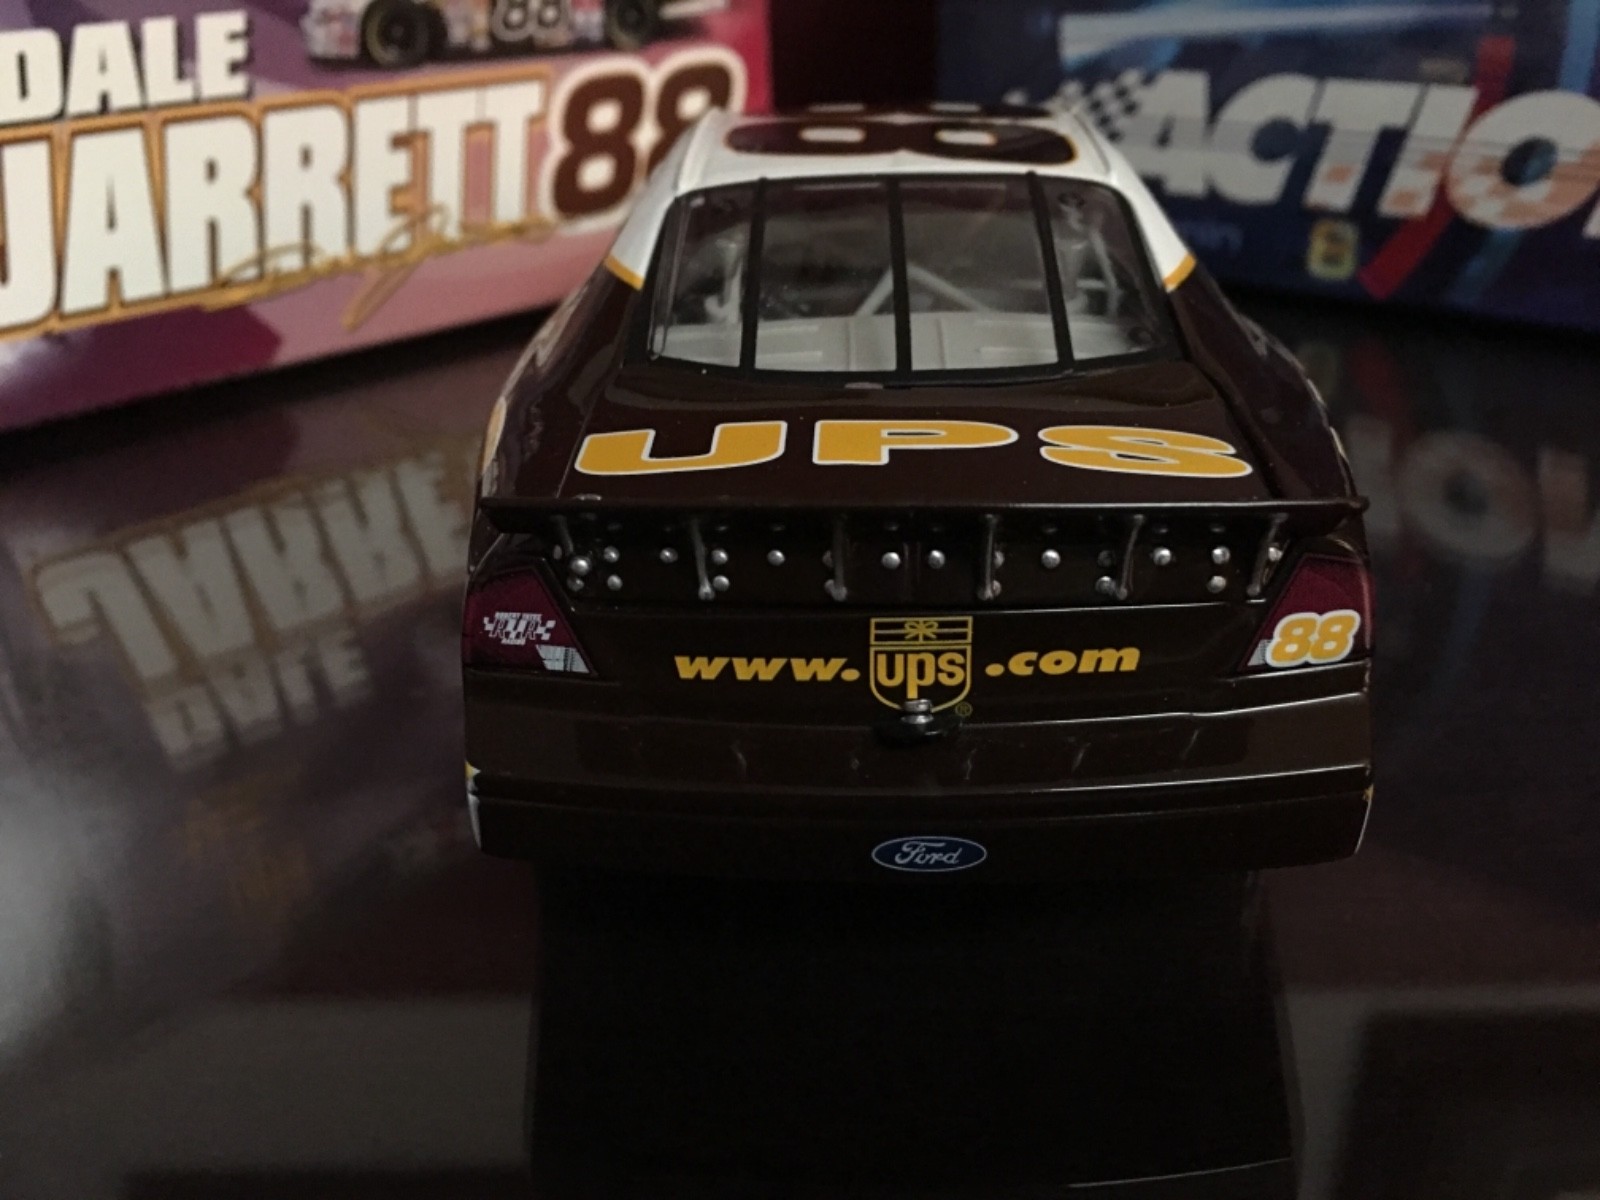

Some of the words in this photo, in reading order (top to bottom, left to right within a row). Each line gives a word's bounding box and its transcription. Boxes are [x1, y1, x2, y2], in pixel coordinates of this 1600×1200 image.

[0, 11, 249, 122] DALE
[1110, 70, 1600, 238] ACTIO
[0, 82, 542, 328] JARRETT
[575, 420, 1252, 477] UPS
[1265, 609, 1361, 667] 88
[674, 656, 861, 681] www.
[877, 652, 965, 699] ups
[985, 647, 1140, 677] .com
[895, 841, 962, 864] Ford
